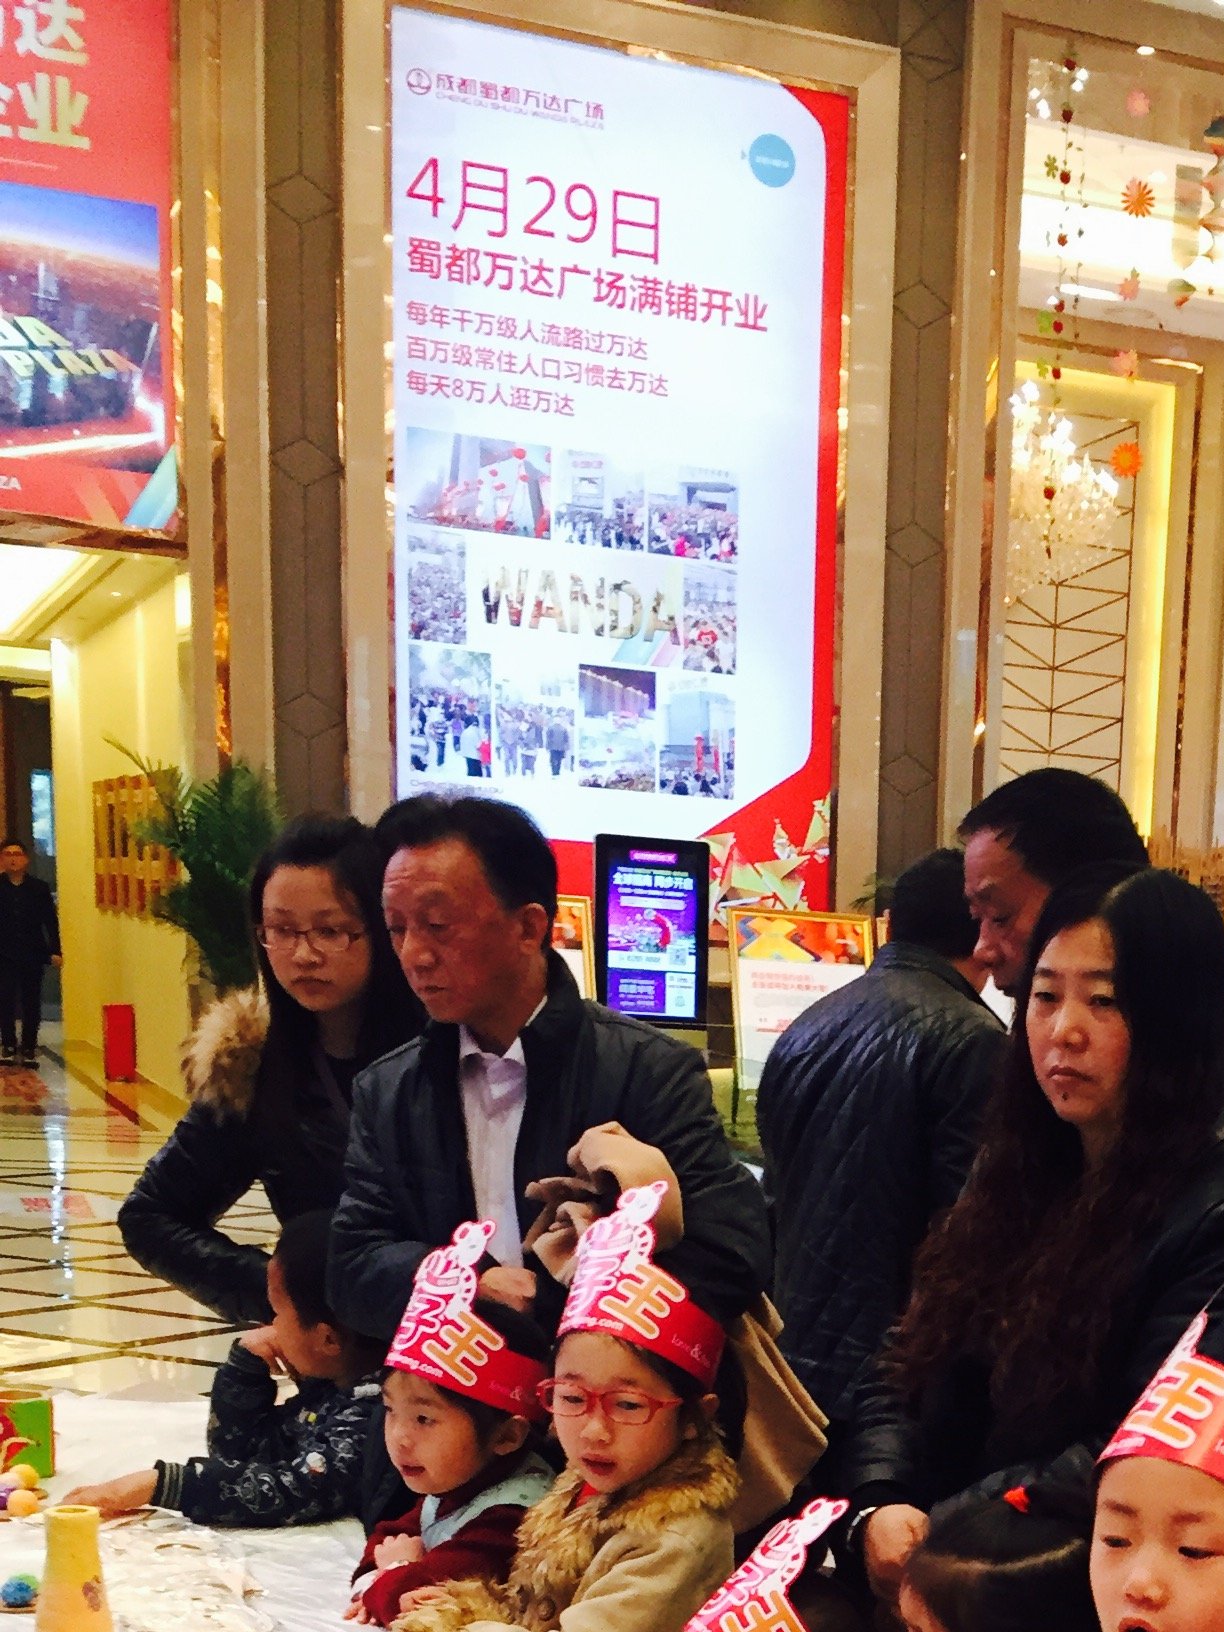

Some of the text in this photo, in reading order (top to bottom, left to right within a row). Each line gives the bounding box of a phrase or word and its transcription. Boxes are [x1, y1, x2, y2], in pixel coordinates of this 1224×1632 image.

[0, 0, 90, 67] 达
[0, 72, 92, 151] 业
[436, 73, 605, 120] 成都蜀都万达广场
[406, 156, 661, 265] 4月29日
[406, 236, 769, 333] 蜀都万达广场满铺开业
[406, 299, 649, 361] 每年千万级人流路过万达
[406, 335, 669, 397] 百万级常住人口习惯去万达
[406, 369, 576, 417] 每天8万人逛万达
[482, 565, 681, 646] WANDA
